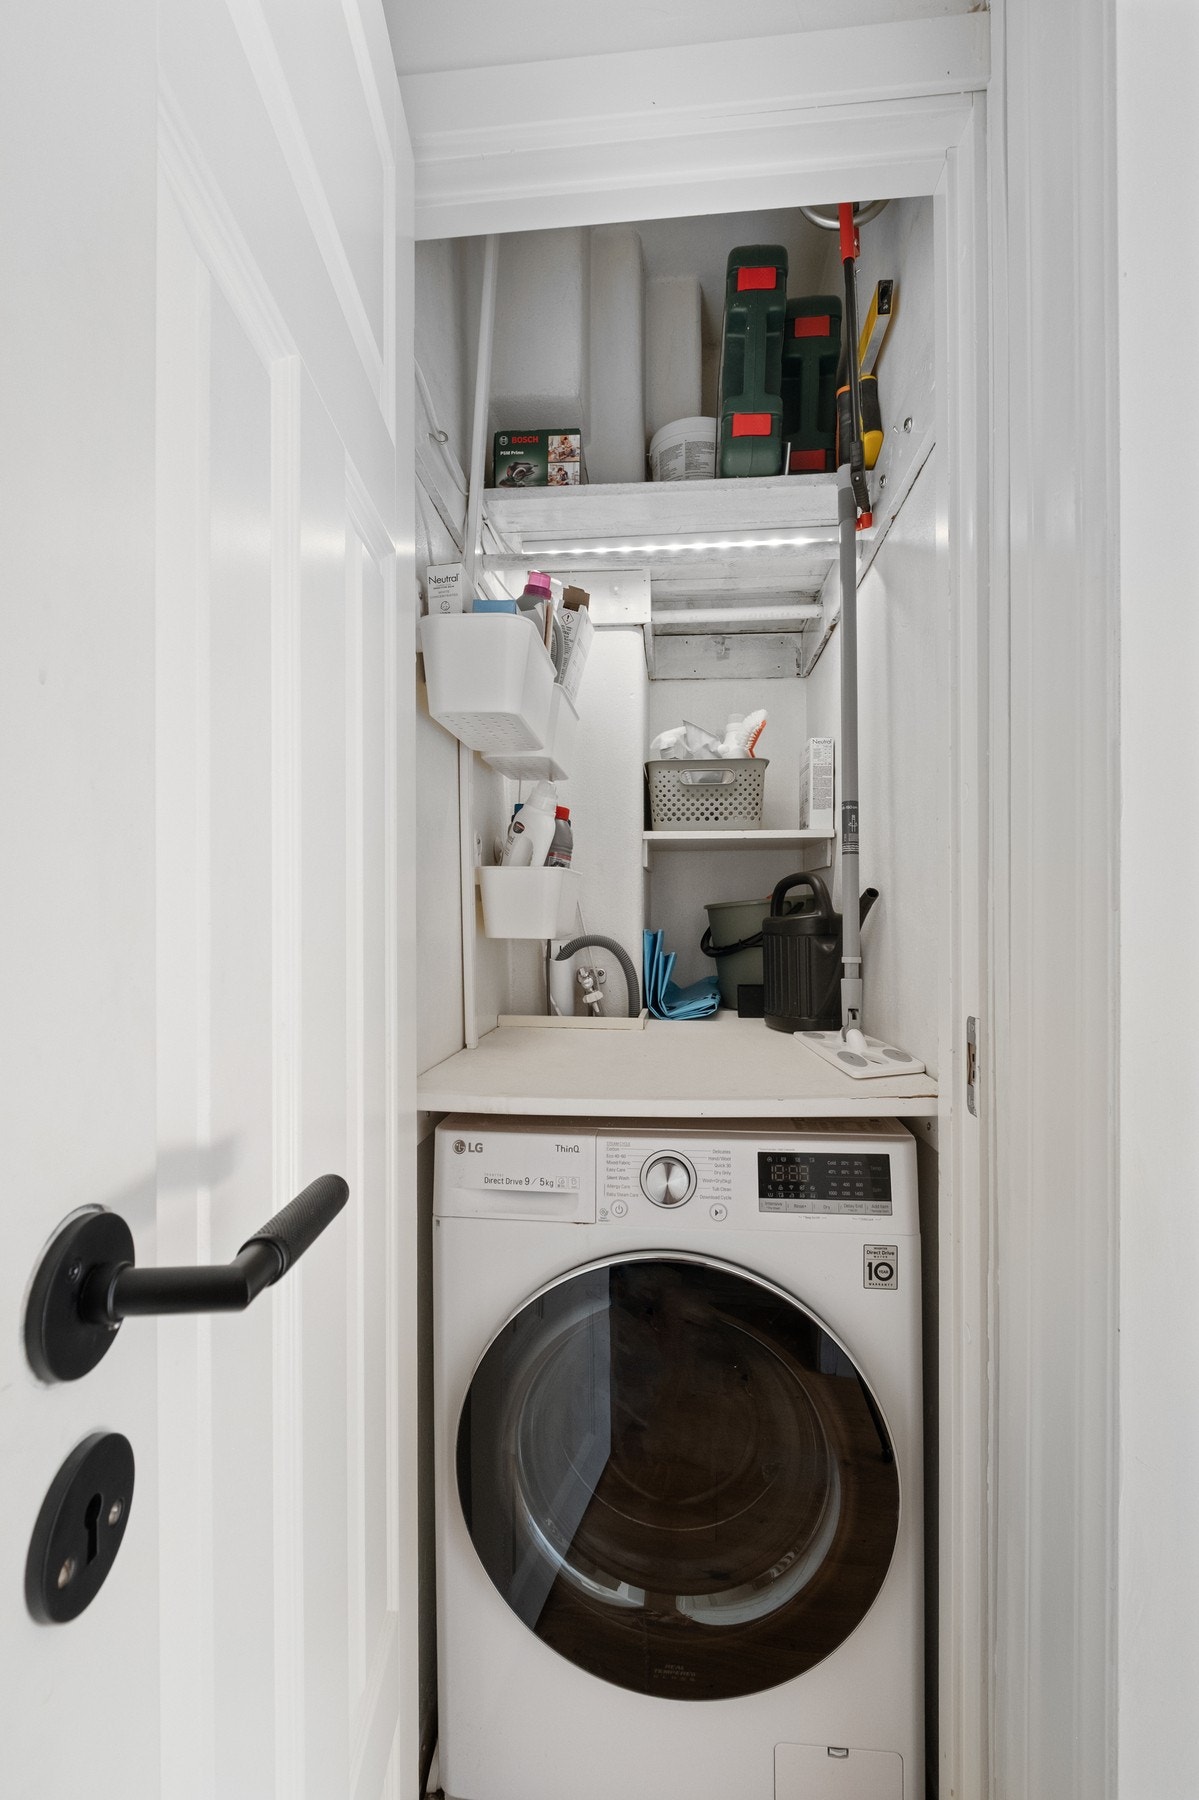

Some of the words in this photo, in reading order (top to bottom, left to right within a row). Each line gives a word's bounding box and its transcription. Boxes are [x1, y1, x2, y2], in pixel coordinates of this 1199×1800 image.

[511, 436, 539, 444] BOSCH
[428, 573, 460, 584] Neutral
[468, 1142, 484, 1153] LG
[555, 1144, 580, 1153] ThinQ
[484, 1177, 504, 1185] Direct
[524, 1177, 530, 1186] 9
[867, 1262, 894, 1281] 10
